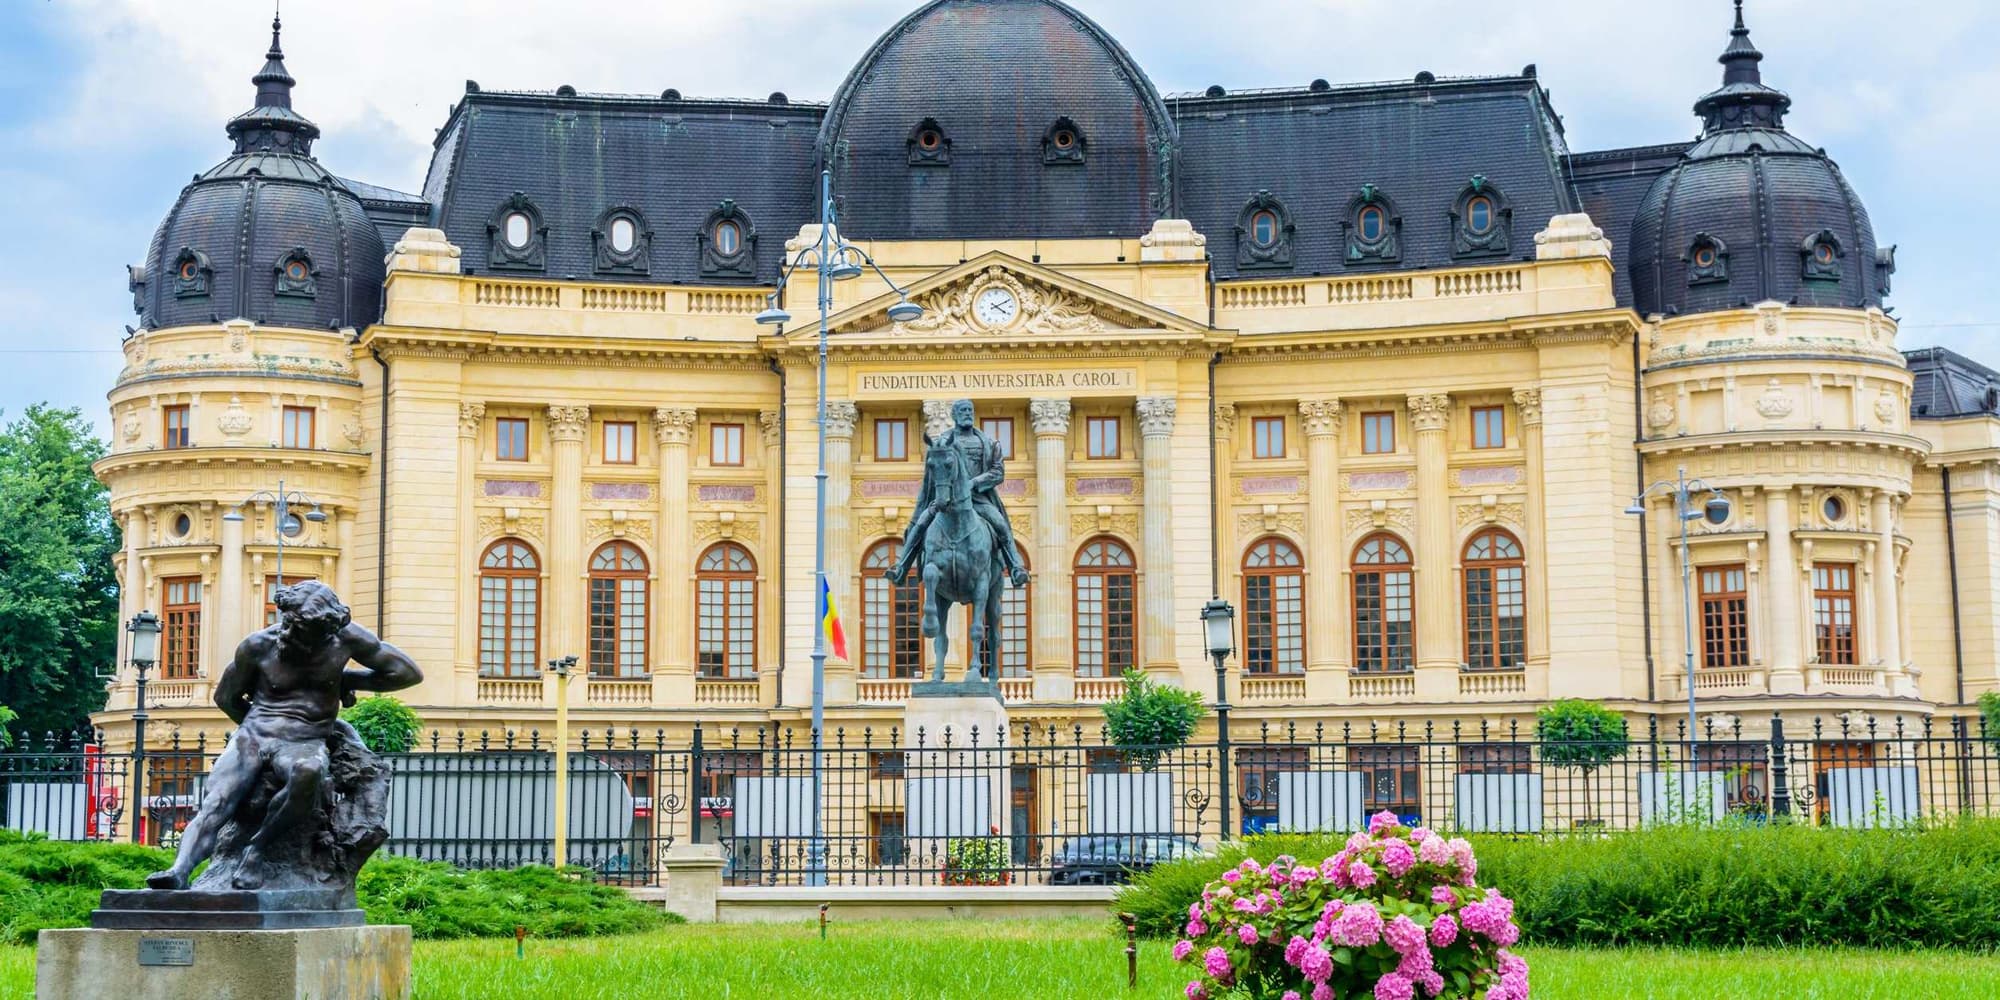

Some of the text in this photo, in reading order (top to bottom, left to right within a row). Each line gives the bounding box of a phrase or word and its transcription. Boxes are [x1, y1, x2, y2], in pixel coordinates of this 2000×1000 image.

[863, 375, 957, 389] FUNDATIUNEA
[963, 373, 1065, 388] UNIVERSITARA
[1072, 372, 1120, 386] CAROL
